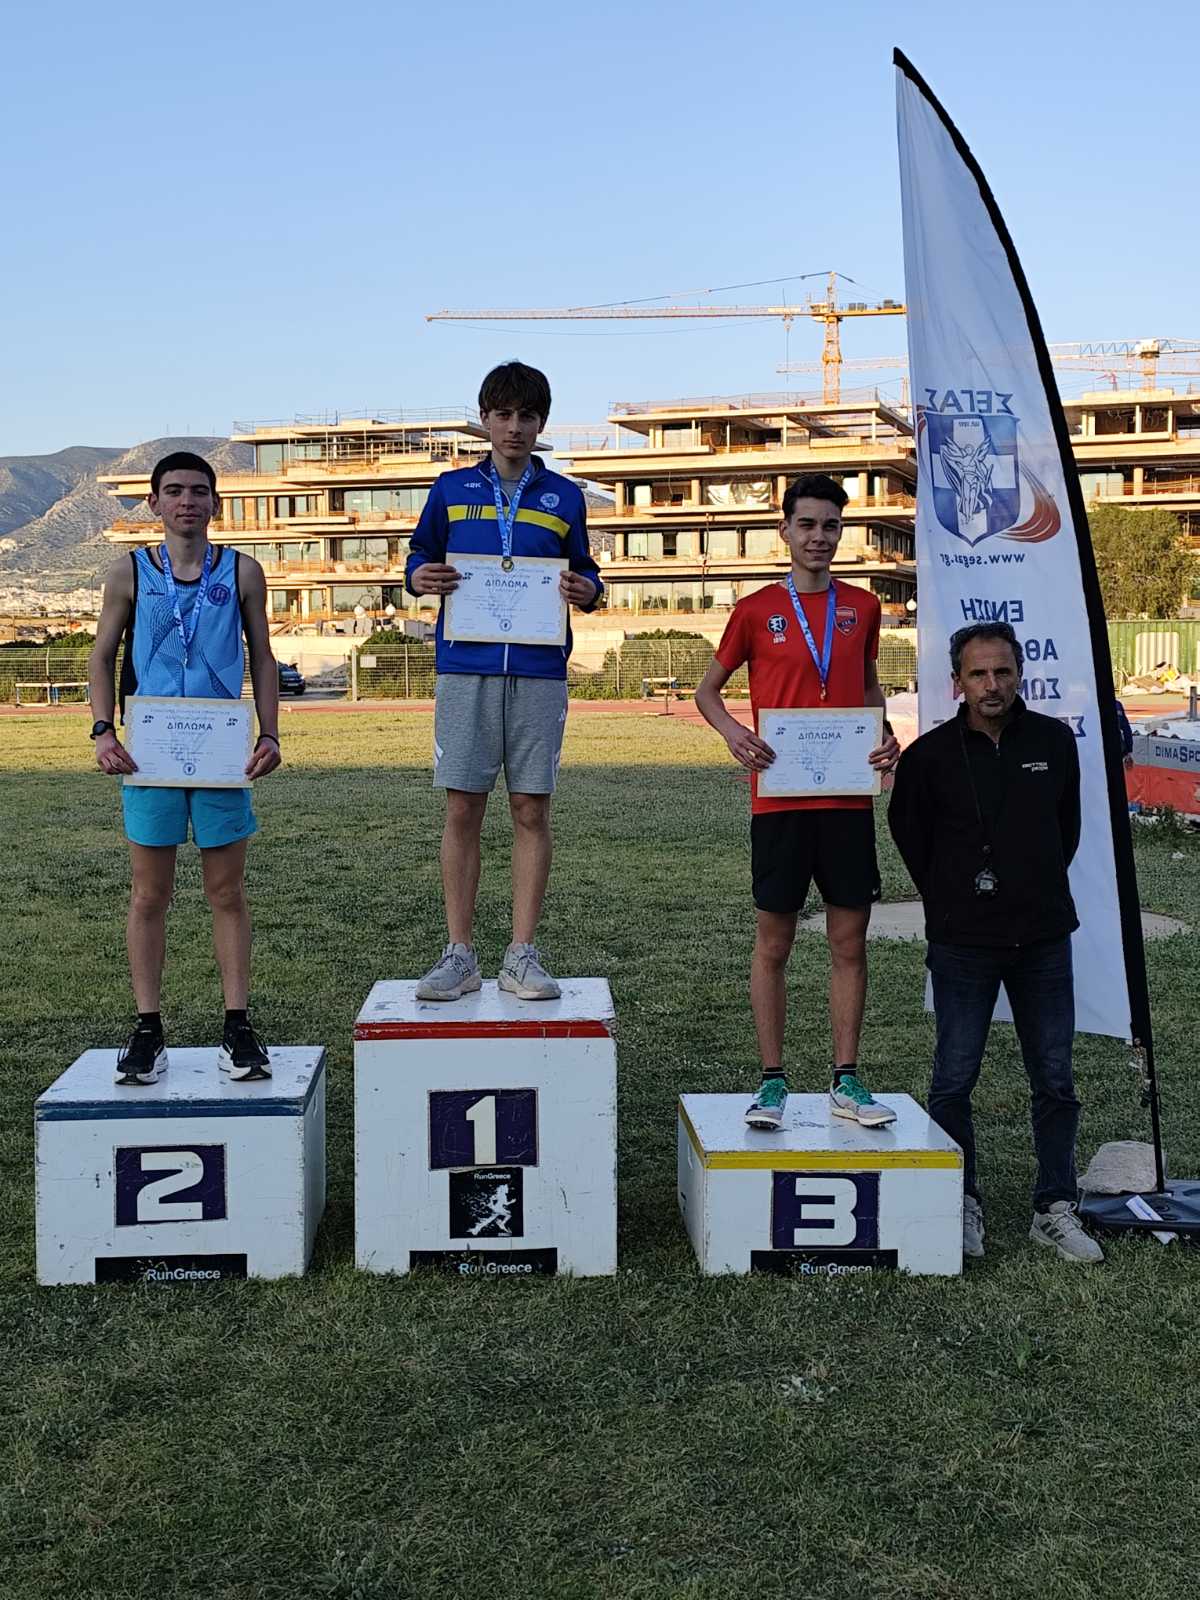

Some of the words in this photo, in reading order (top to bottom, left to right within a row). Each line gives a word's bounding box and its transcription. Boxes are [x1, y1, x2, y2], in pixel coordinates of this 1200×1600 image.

[484, 578, 528, 589] ΔΙΠΛΩΜΑ
[167, 721, 213, 731] ΔΙΠΛΩΜΑ
[798, 731, 842, 740] ΔΙΠΛΩΜΑ
[465, 1095, 496, 1165] 1
[136, 1150, 204, 1222] 2
[793, 1177, 858, 1248] 3
[146, 1266, 221, 1281] RunGreece
[458, 1261, 533, 1275] RunGreece
